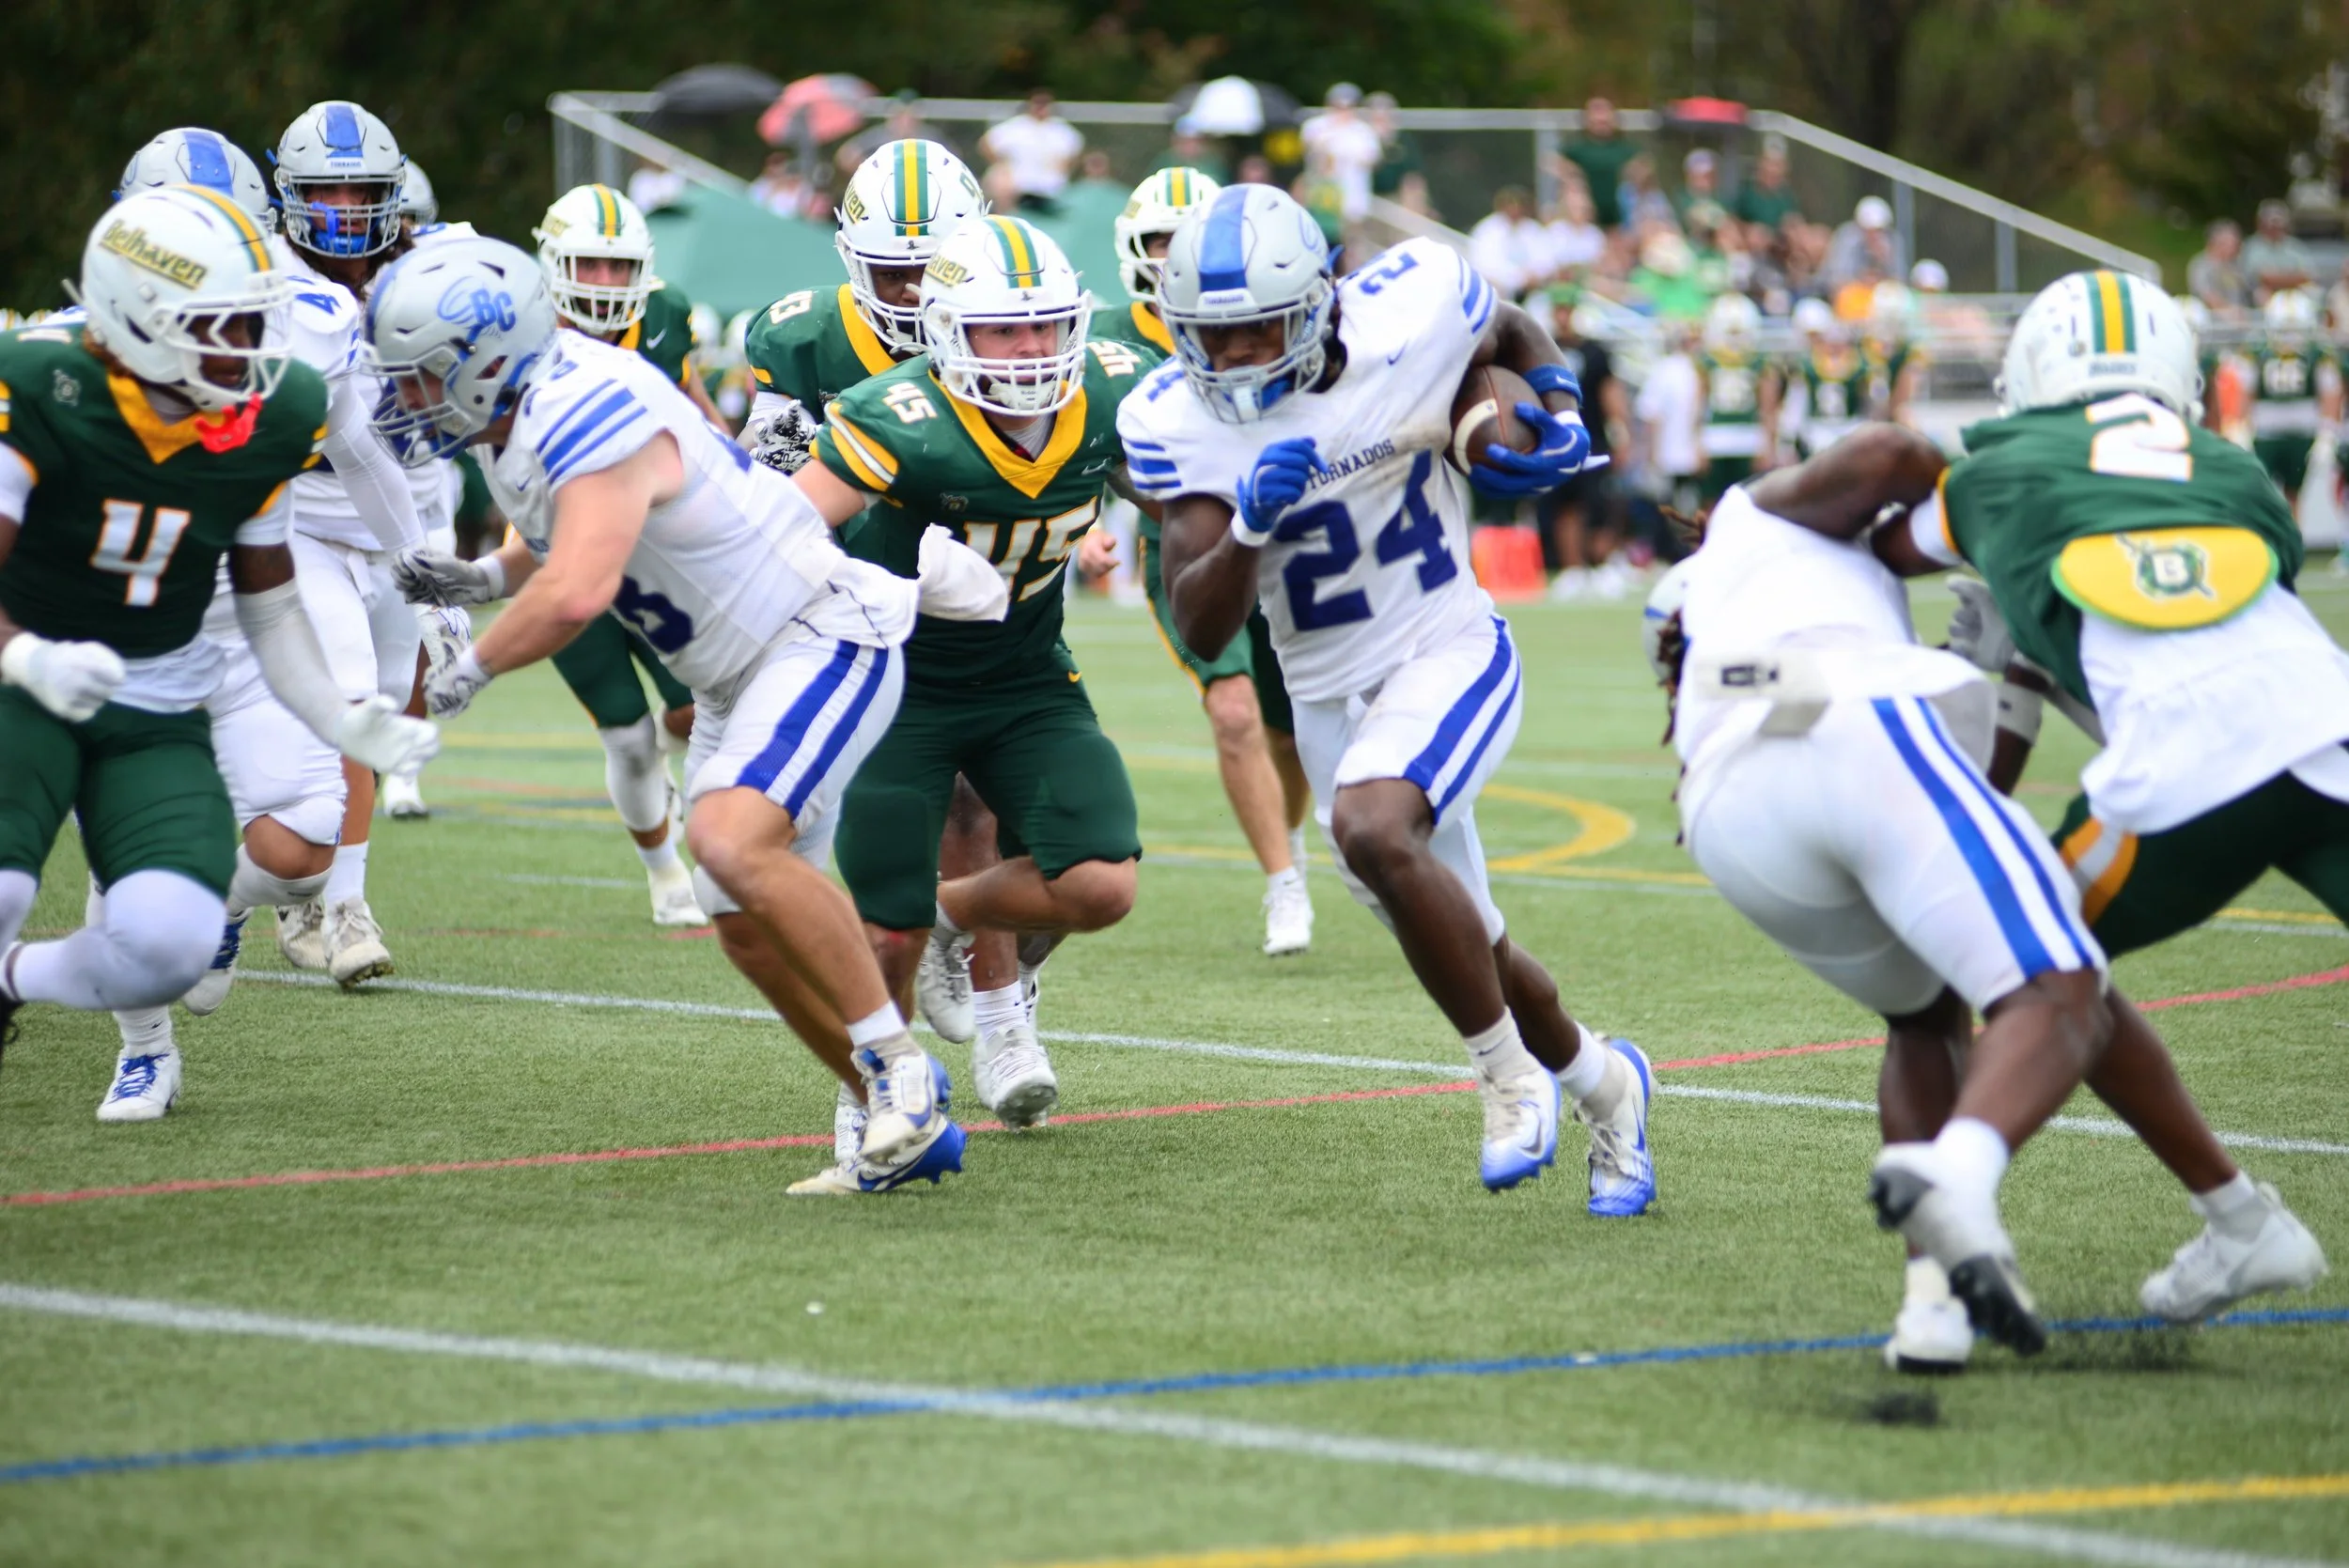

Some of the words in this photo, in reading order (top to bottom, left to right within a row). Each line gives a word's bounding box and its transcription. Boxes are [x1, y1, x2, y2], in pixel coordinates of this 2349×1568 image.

[100, 218, 209, 288] Belhaven
[881, 381, 938, 424] 45
[2085, 393, 2193, 483] 2
[89, 498, 191, 607] 4
[963, 495, 1097, 601] 45
[1272, 449, 1458, 631] 24
